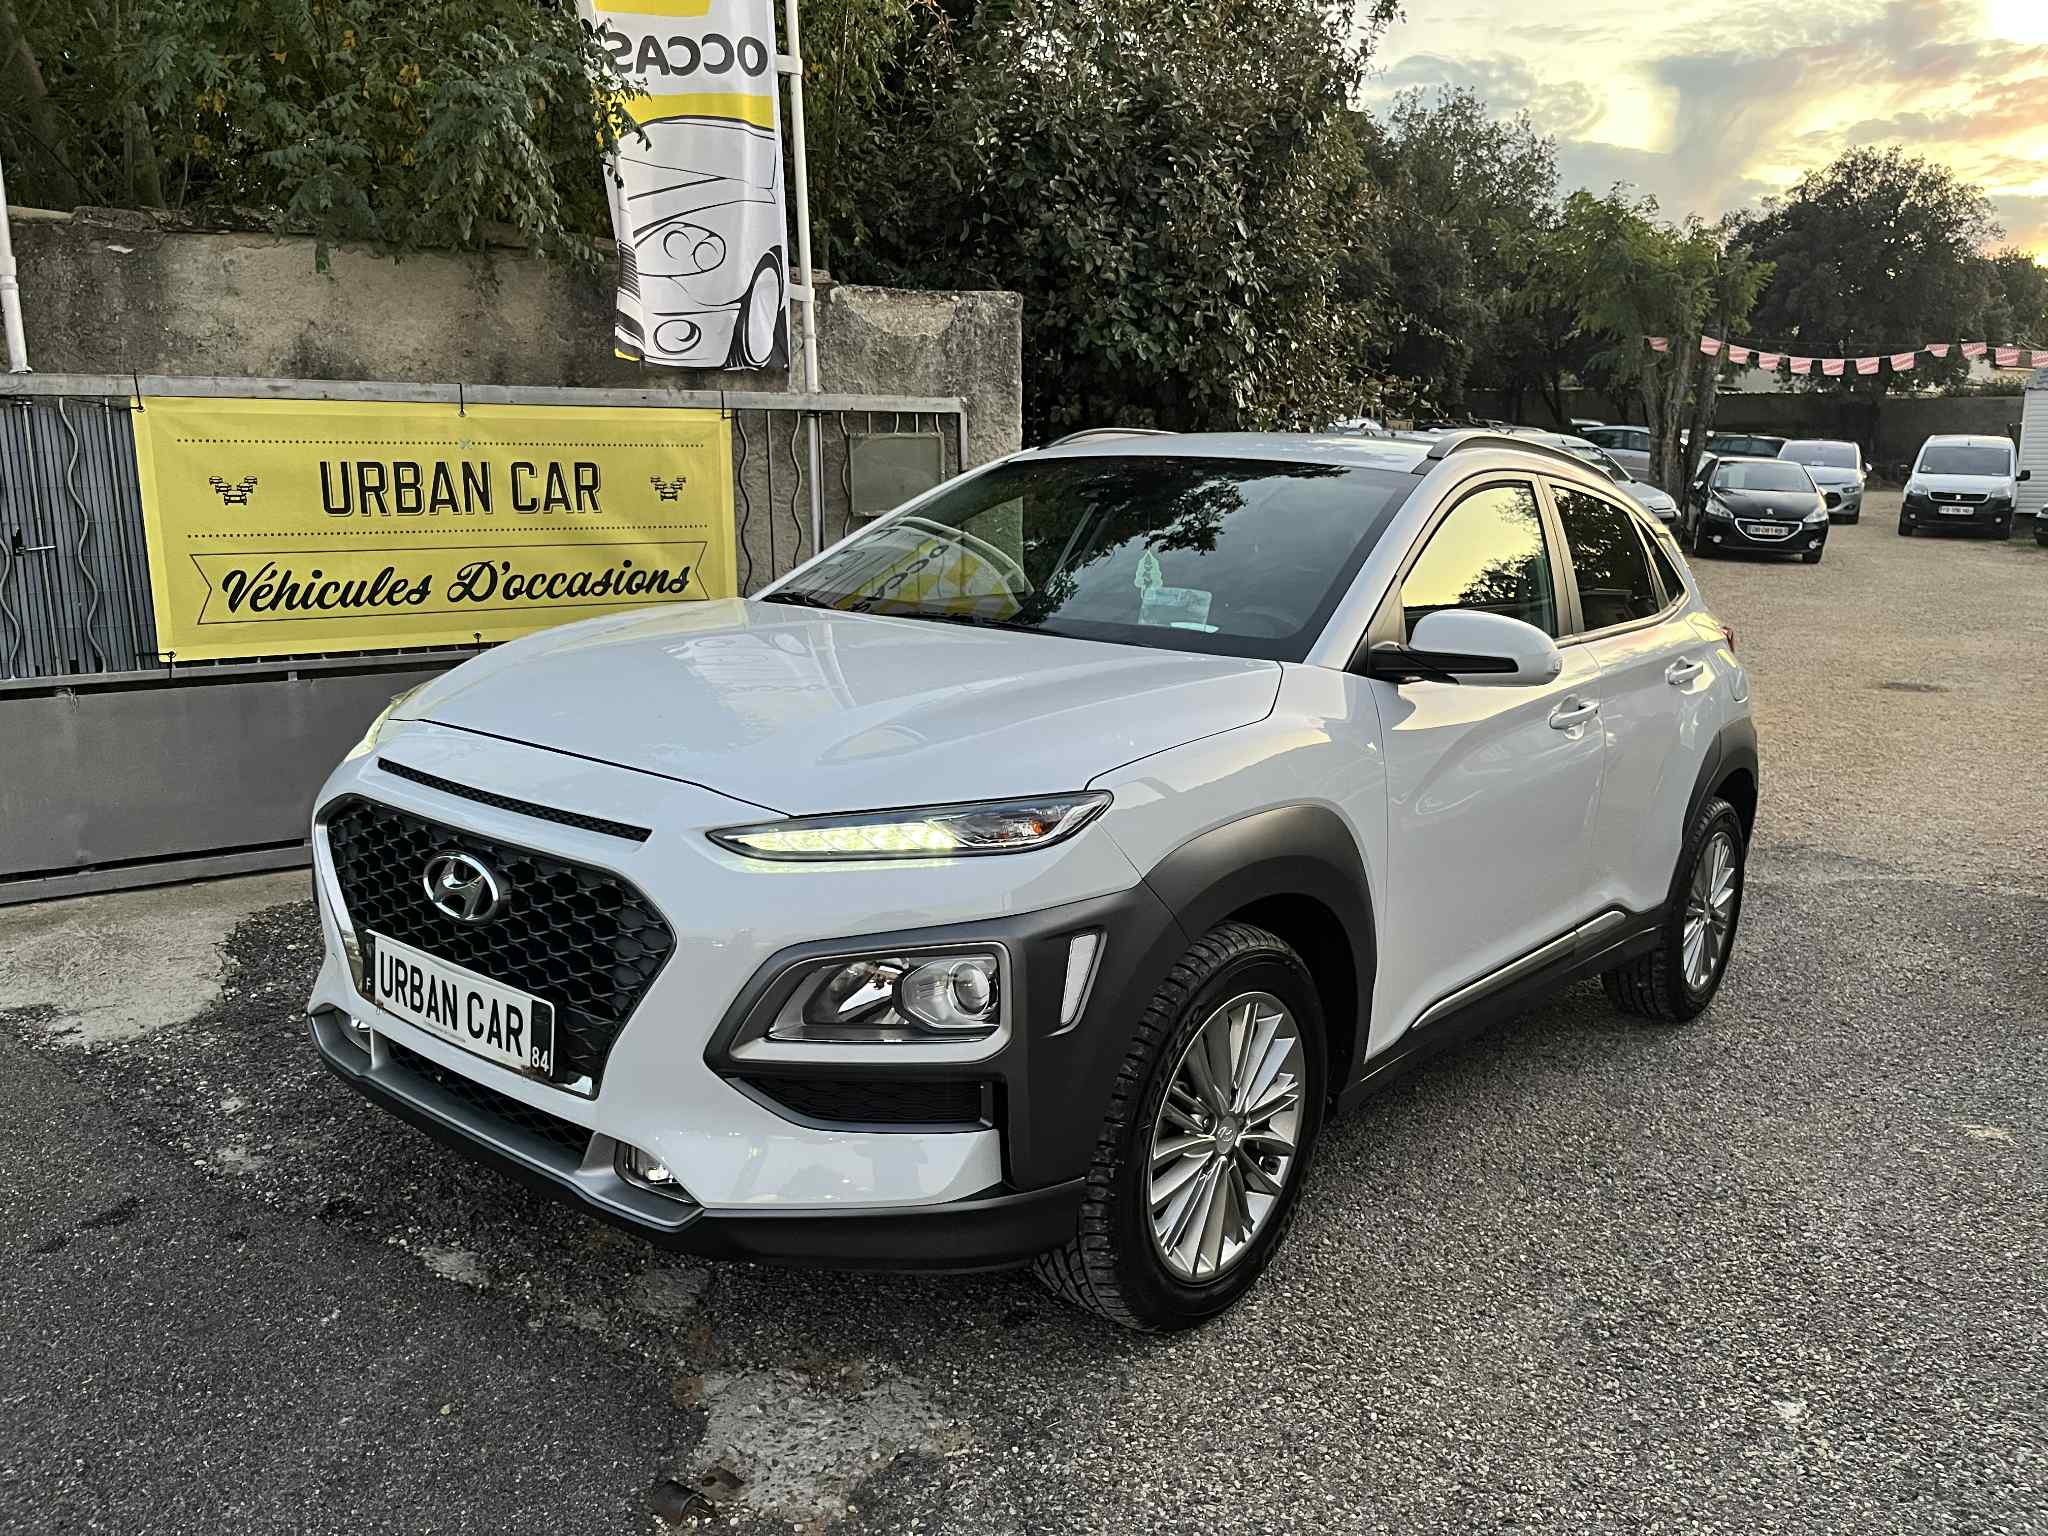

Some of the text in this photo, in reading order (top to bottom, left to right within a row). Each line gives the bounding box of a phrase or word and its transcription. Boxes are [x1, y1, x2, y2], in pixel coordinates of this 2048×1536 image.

[320, 461, 602, 517] URBAN CAR
[222, 559, 691, 614] Véhicules D'occasions
[380, 951, 524, 1058] URBAN CAR
[531, 1046, 550, 1072] 84
